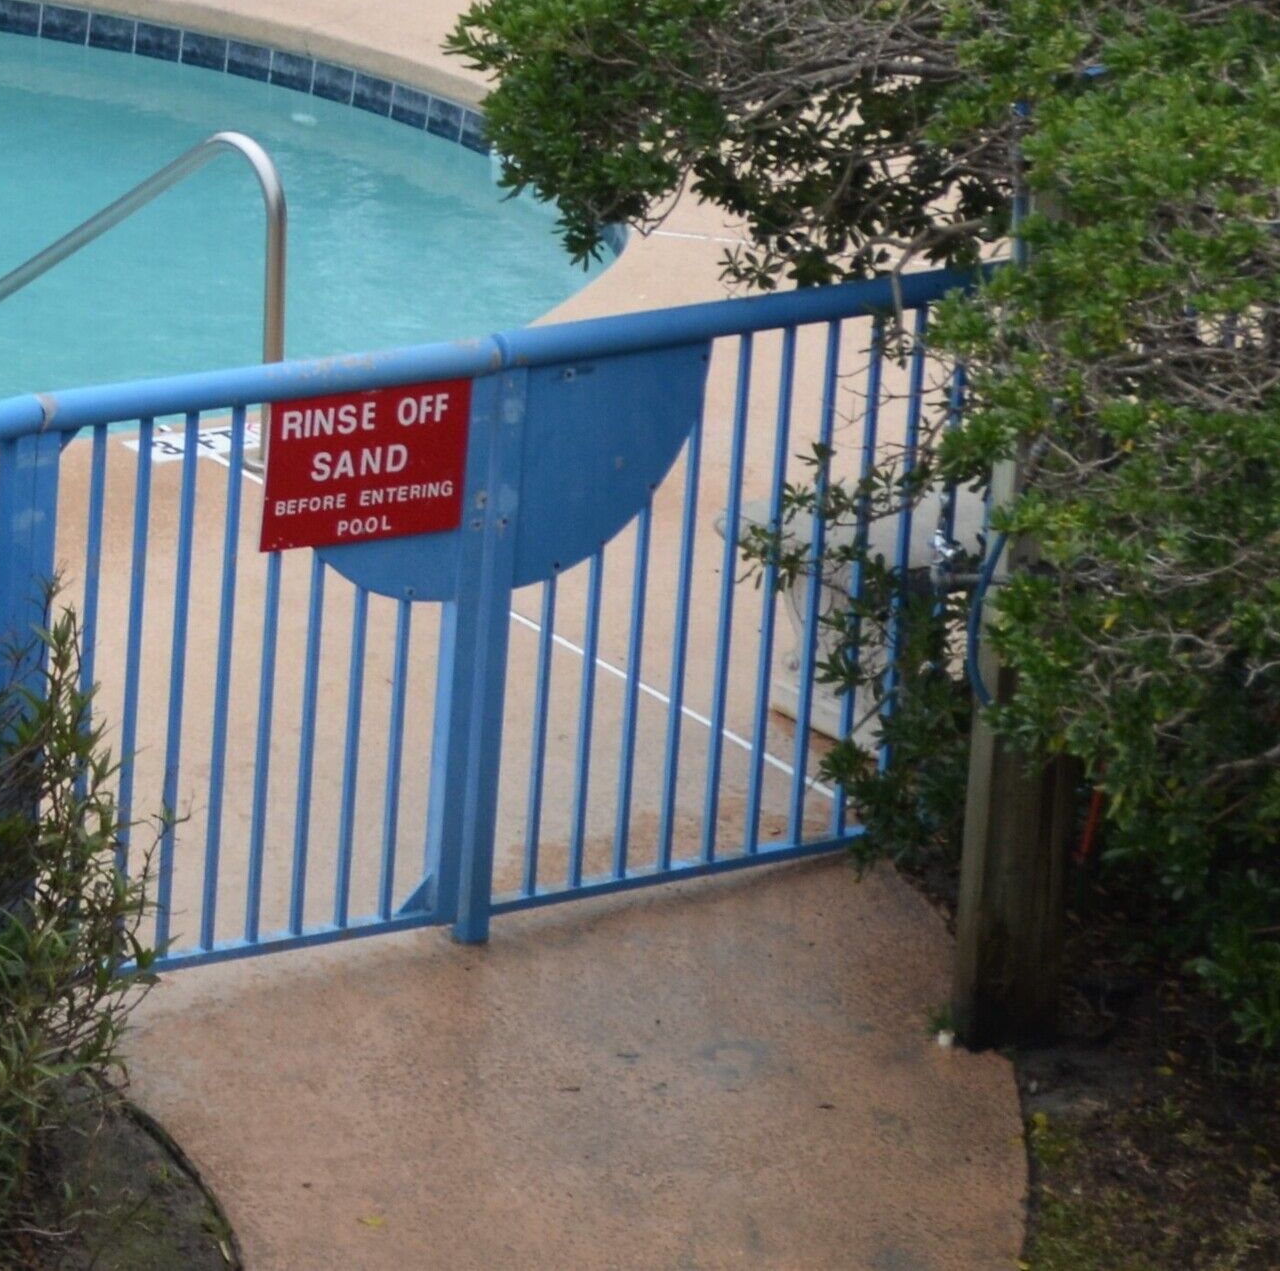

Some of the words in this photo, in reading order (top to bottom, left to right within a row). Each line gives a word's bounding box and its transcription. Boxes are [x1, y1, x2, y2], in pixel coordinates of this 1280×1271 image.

[281, 401, 376, 441] RINSE
[397, 393, 450, 427] OFF
[310, 443, 409, 482] SAND
[274, 493, 348, 516] BEFORE
[358, 480, 454, 507] ENTERING
[336, 515, 392, 537] POOL
